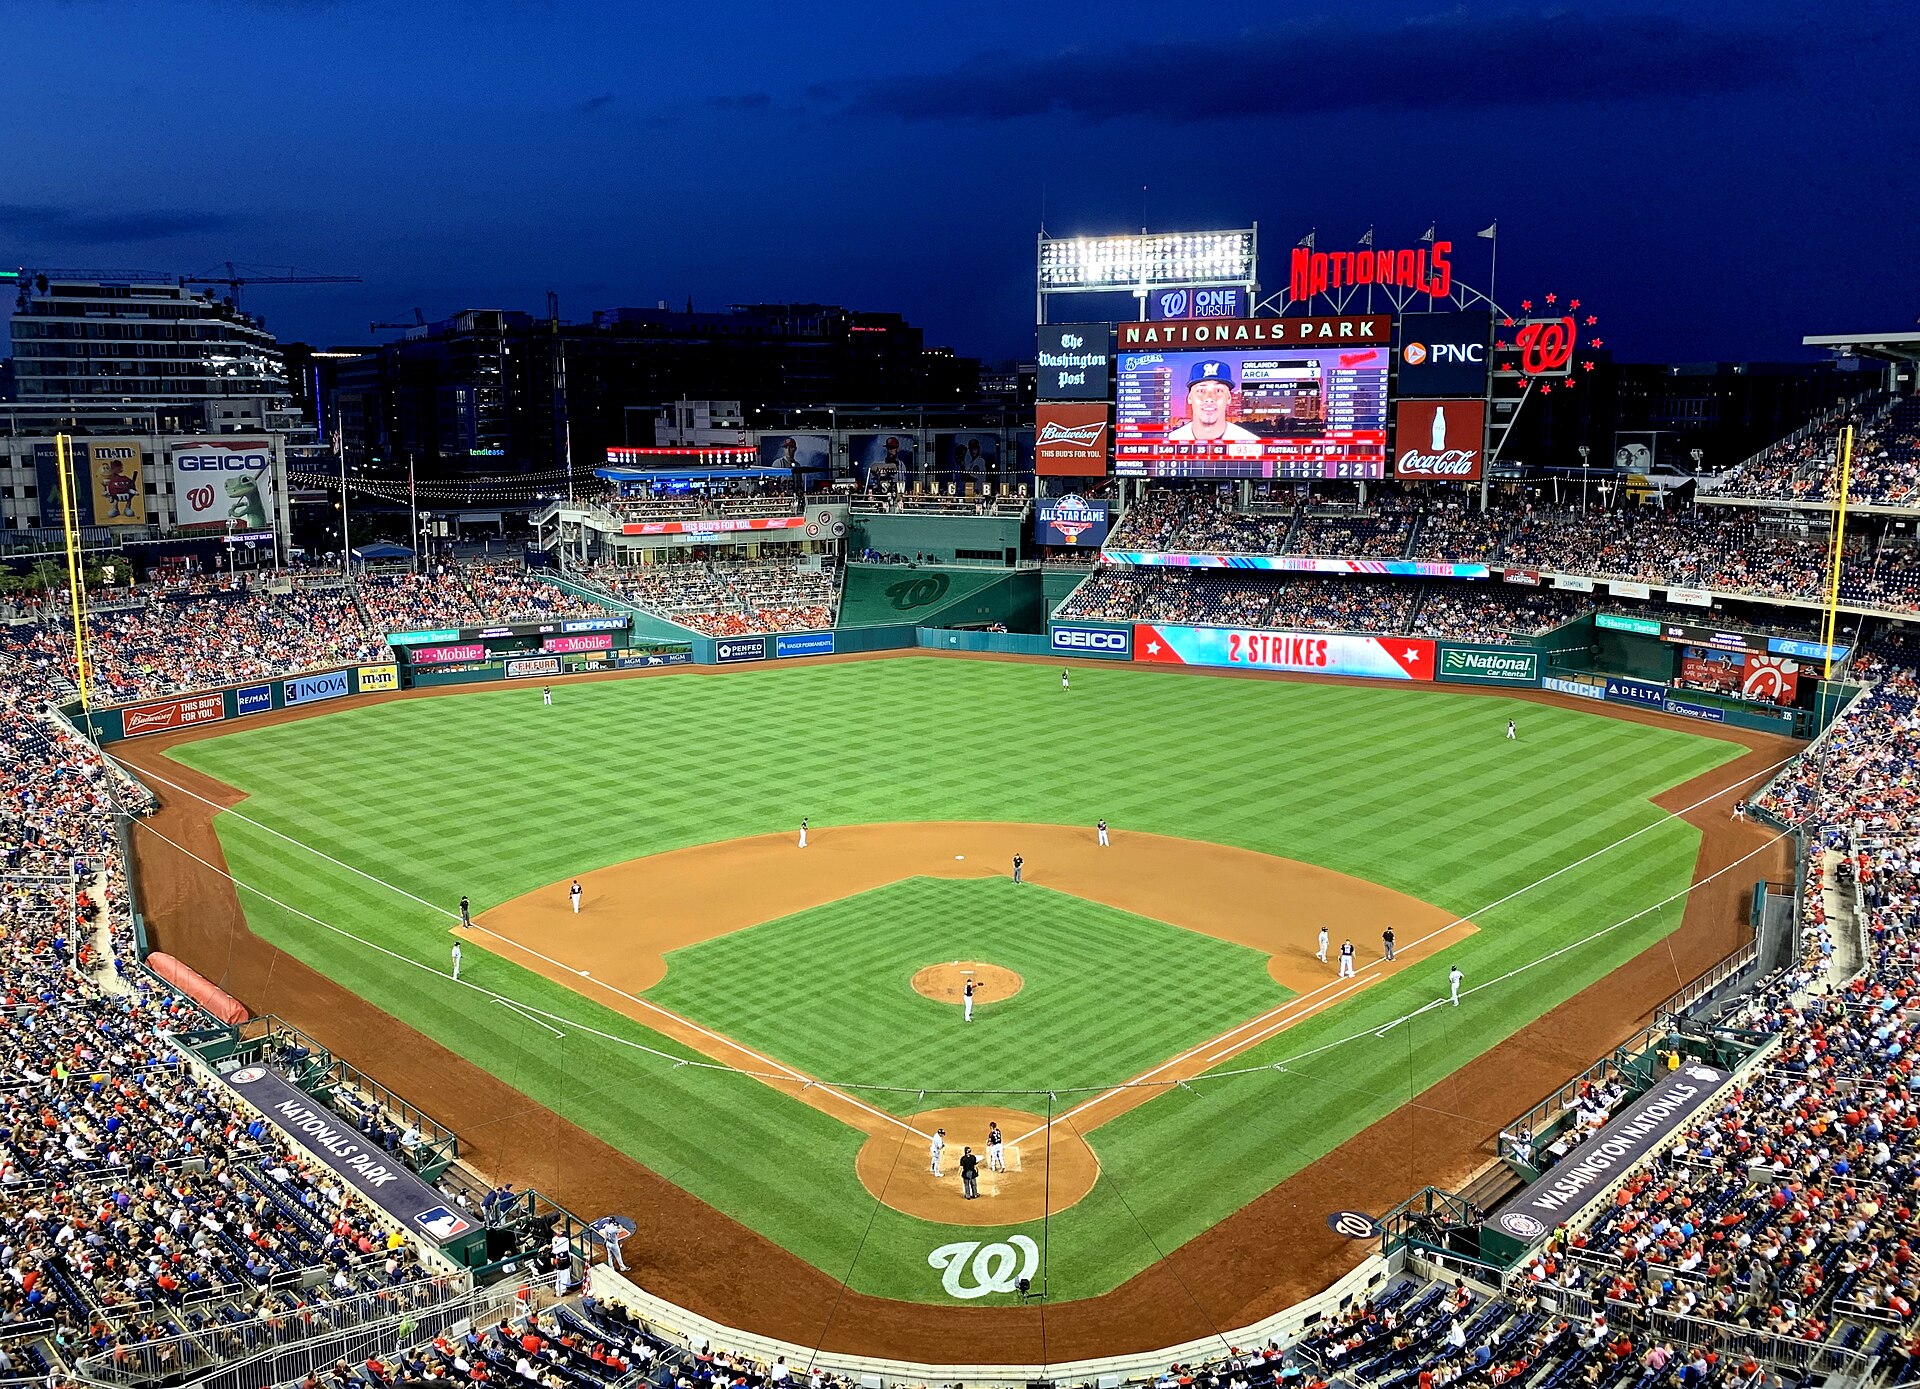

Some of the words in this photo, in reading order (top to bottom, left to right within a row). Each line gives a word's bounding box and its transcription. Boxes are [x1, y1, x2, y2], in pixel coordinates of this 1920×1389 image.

[1290, 241, 1452, 302] NATIONALS
[1196, 290, 1236, 305] ONE
[1195, 304, 1236, 317] PURSUIT
[1126, 324, 1285, 344] NATIONALS
[1300, 321, 1376, 338] PARK
[1060, 334, 1084, 349] The
[1038, 351, 1107, 368] Washington
[1430, 343, 1484, 363] PNC
[1058, 371, 1086, 388] Post
[1043, 427, 1098, 439] Budweiser
[469, 448, 505, 456] lendlease
[1040, 450, 1055, 458] THIS
[1055, 450, 1074, 458] BUD'S
[1074, 450, 1087, 458] FOR
[178, 454, 267, 472] GEICO
[1338, 464, 1348, 476] 2
[1353, 464, 1363, 476] 2
[1370, 463, 1377, 475] 1
[1397, 449, 1478, 475] Coca-Cola
[1056, 509, 1080, 522] STAR
[1080, 509, 1105, 522] GAME
[681, 521, 698, 531] THIS
[698, 521, 720, 531] BUD'S
[721, 520, 735, 530] FOR
[1288, 560, 1317, 571] STRIKES
[1423, 564, 1453, 575] STRIKES
[596, 619, 623, 629] FAN
[731, 643, 763, 652] PENFED
[1054, 631, 1126, 649] GEICO
[1228, 634, 1241, 662] 2
[1248, 635, 1328, 667] STRIKES
[624, 657, 641, 665] MGM
[1501, 670, 1527, 678] Rental
[301, 677, 347, 697] INOVA
[1554, 680, 1600, 698] KOCH
[1621, 685, 1661, 701] DELTA
[180, 701, 198, 713] THIS
[198, 697, 222, 710] BUD'S
[239, 692, 270, 706] RE/MAX
[132, 712, 172, 726] Budweiser
[181, 712, 196, 722] FOR
[197, 709, 215, 720] YOU.
[274, 1098, 359, 1159] NATIONALS
[345, 1151, 398, 1188] PARK
[1532, 1133, 1637, 1212] WASHINGTON
[1619, 1082, 1699, 1140] NATIONALS
